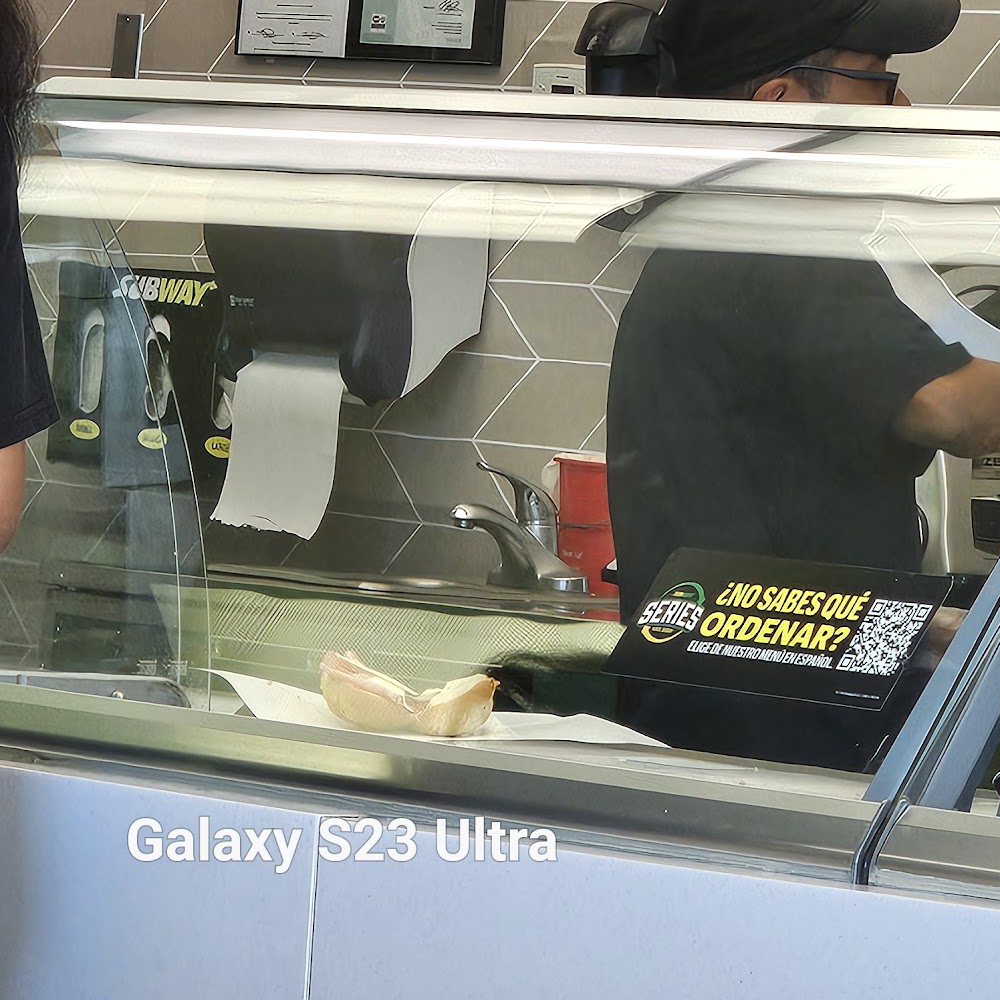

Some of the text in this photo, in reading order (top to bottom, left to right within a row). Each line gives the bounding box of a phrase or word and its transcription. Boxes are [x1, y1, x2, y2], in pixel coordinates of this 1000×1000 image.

[112, 275, 218, 307] SUBWAY
[637, 600, 705, 634] SERIES
[715, 582, 872, 621] ¿NO SABES QUÉ
[699, 611, 851, 652] ORDENAR?
